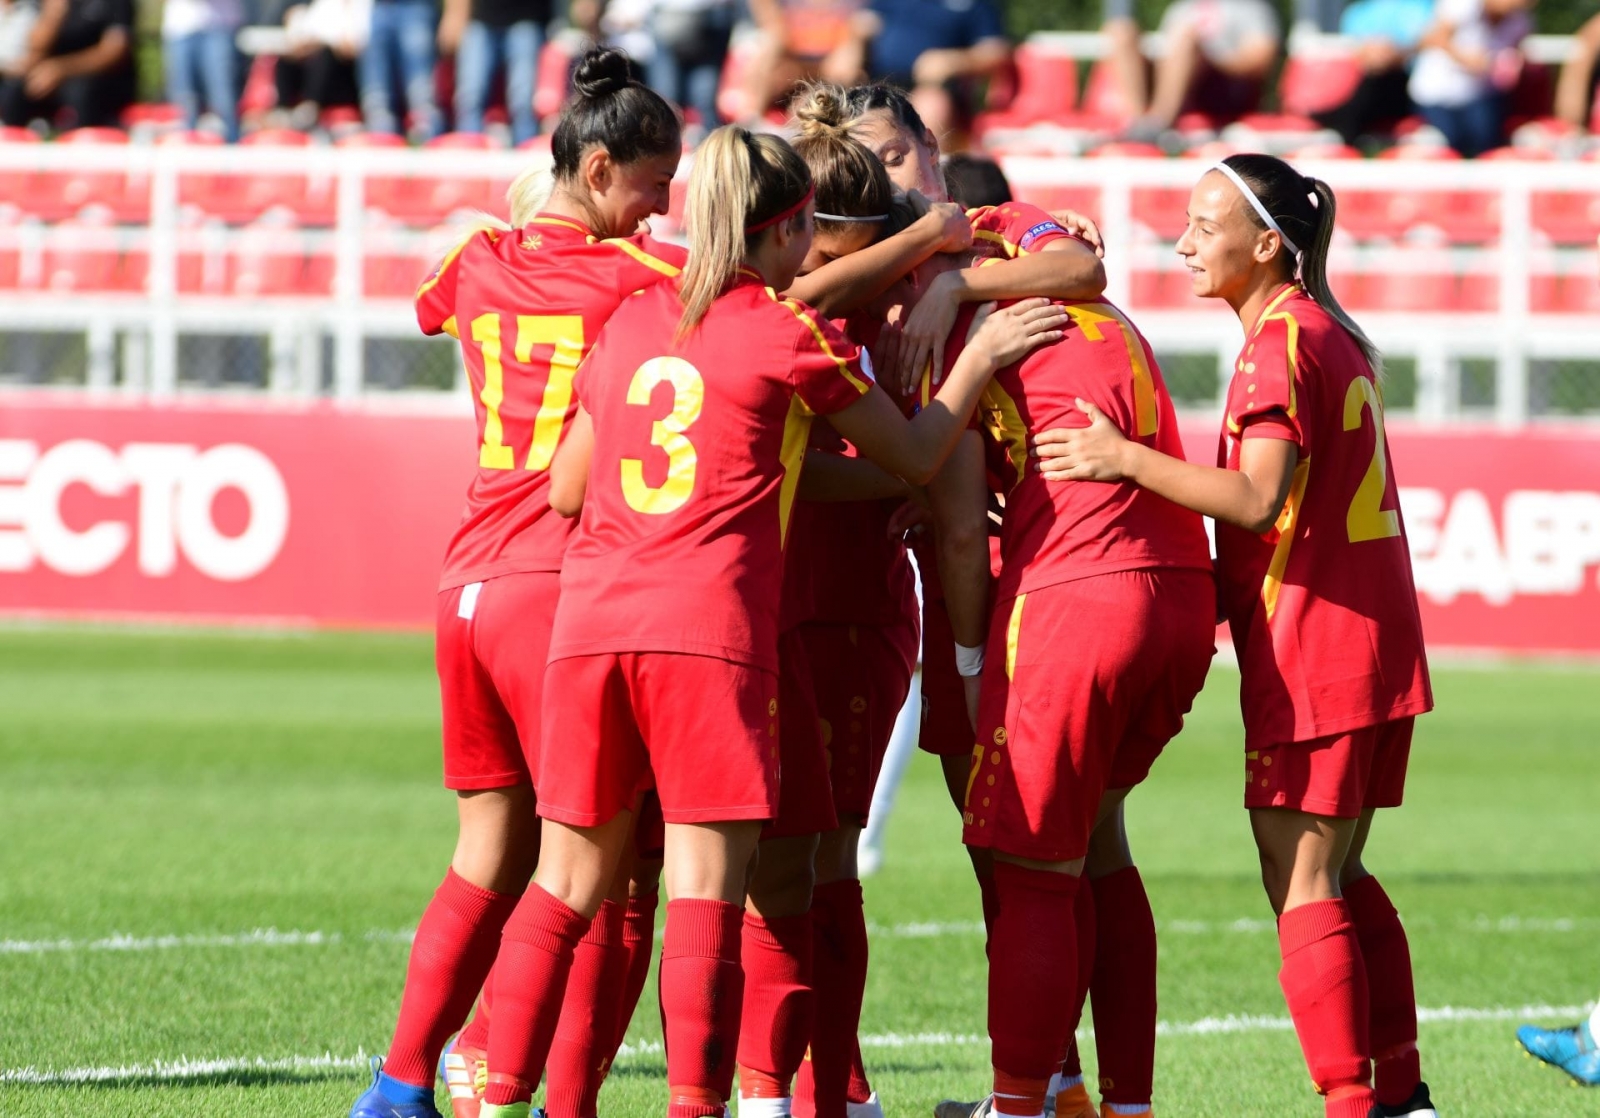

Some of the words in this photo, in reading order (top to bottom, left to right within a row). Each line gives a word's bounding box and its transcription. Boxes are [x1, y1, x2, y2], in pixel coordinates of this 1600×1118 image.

[471, 313, 584, 470] 17
[620, 356, 704, 514] 3
[1343, 375, 1401, 543] 2
[1397, 487, 1600, 606] ЕДЕР
[965, 744, 985, 807] 7
